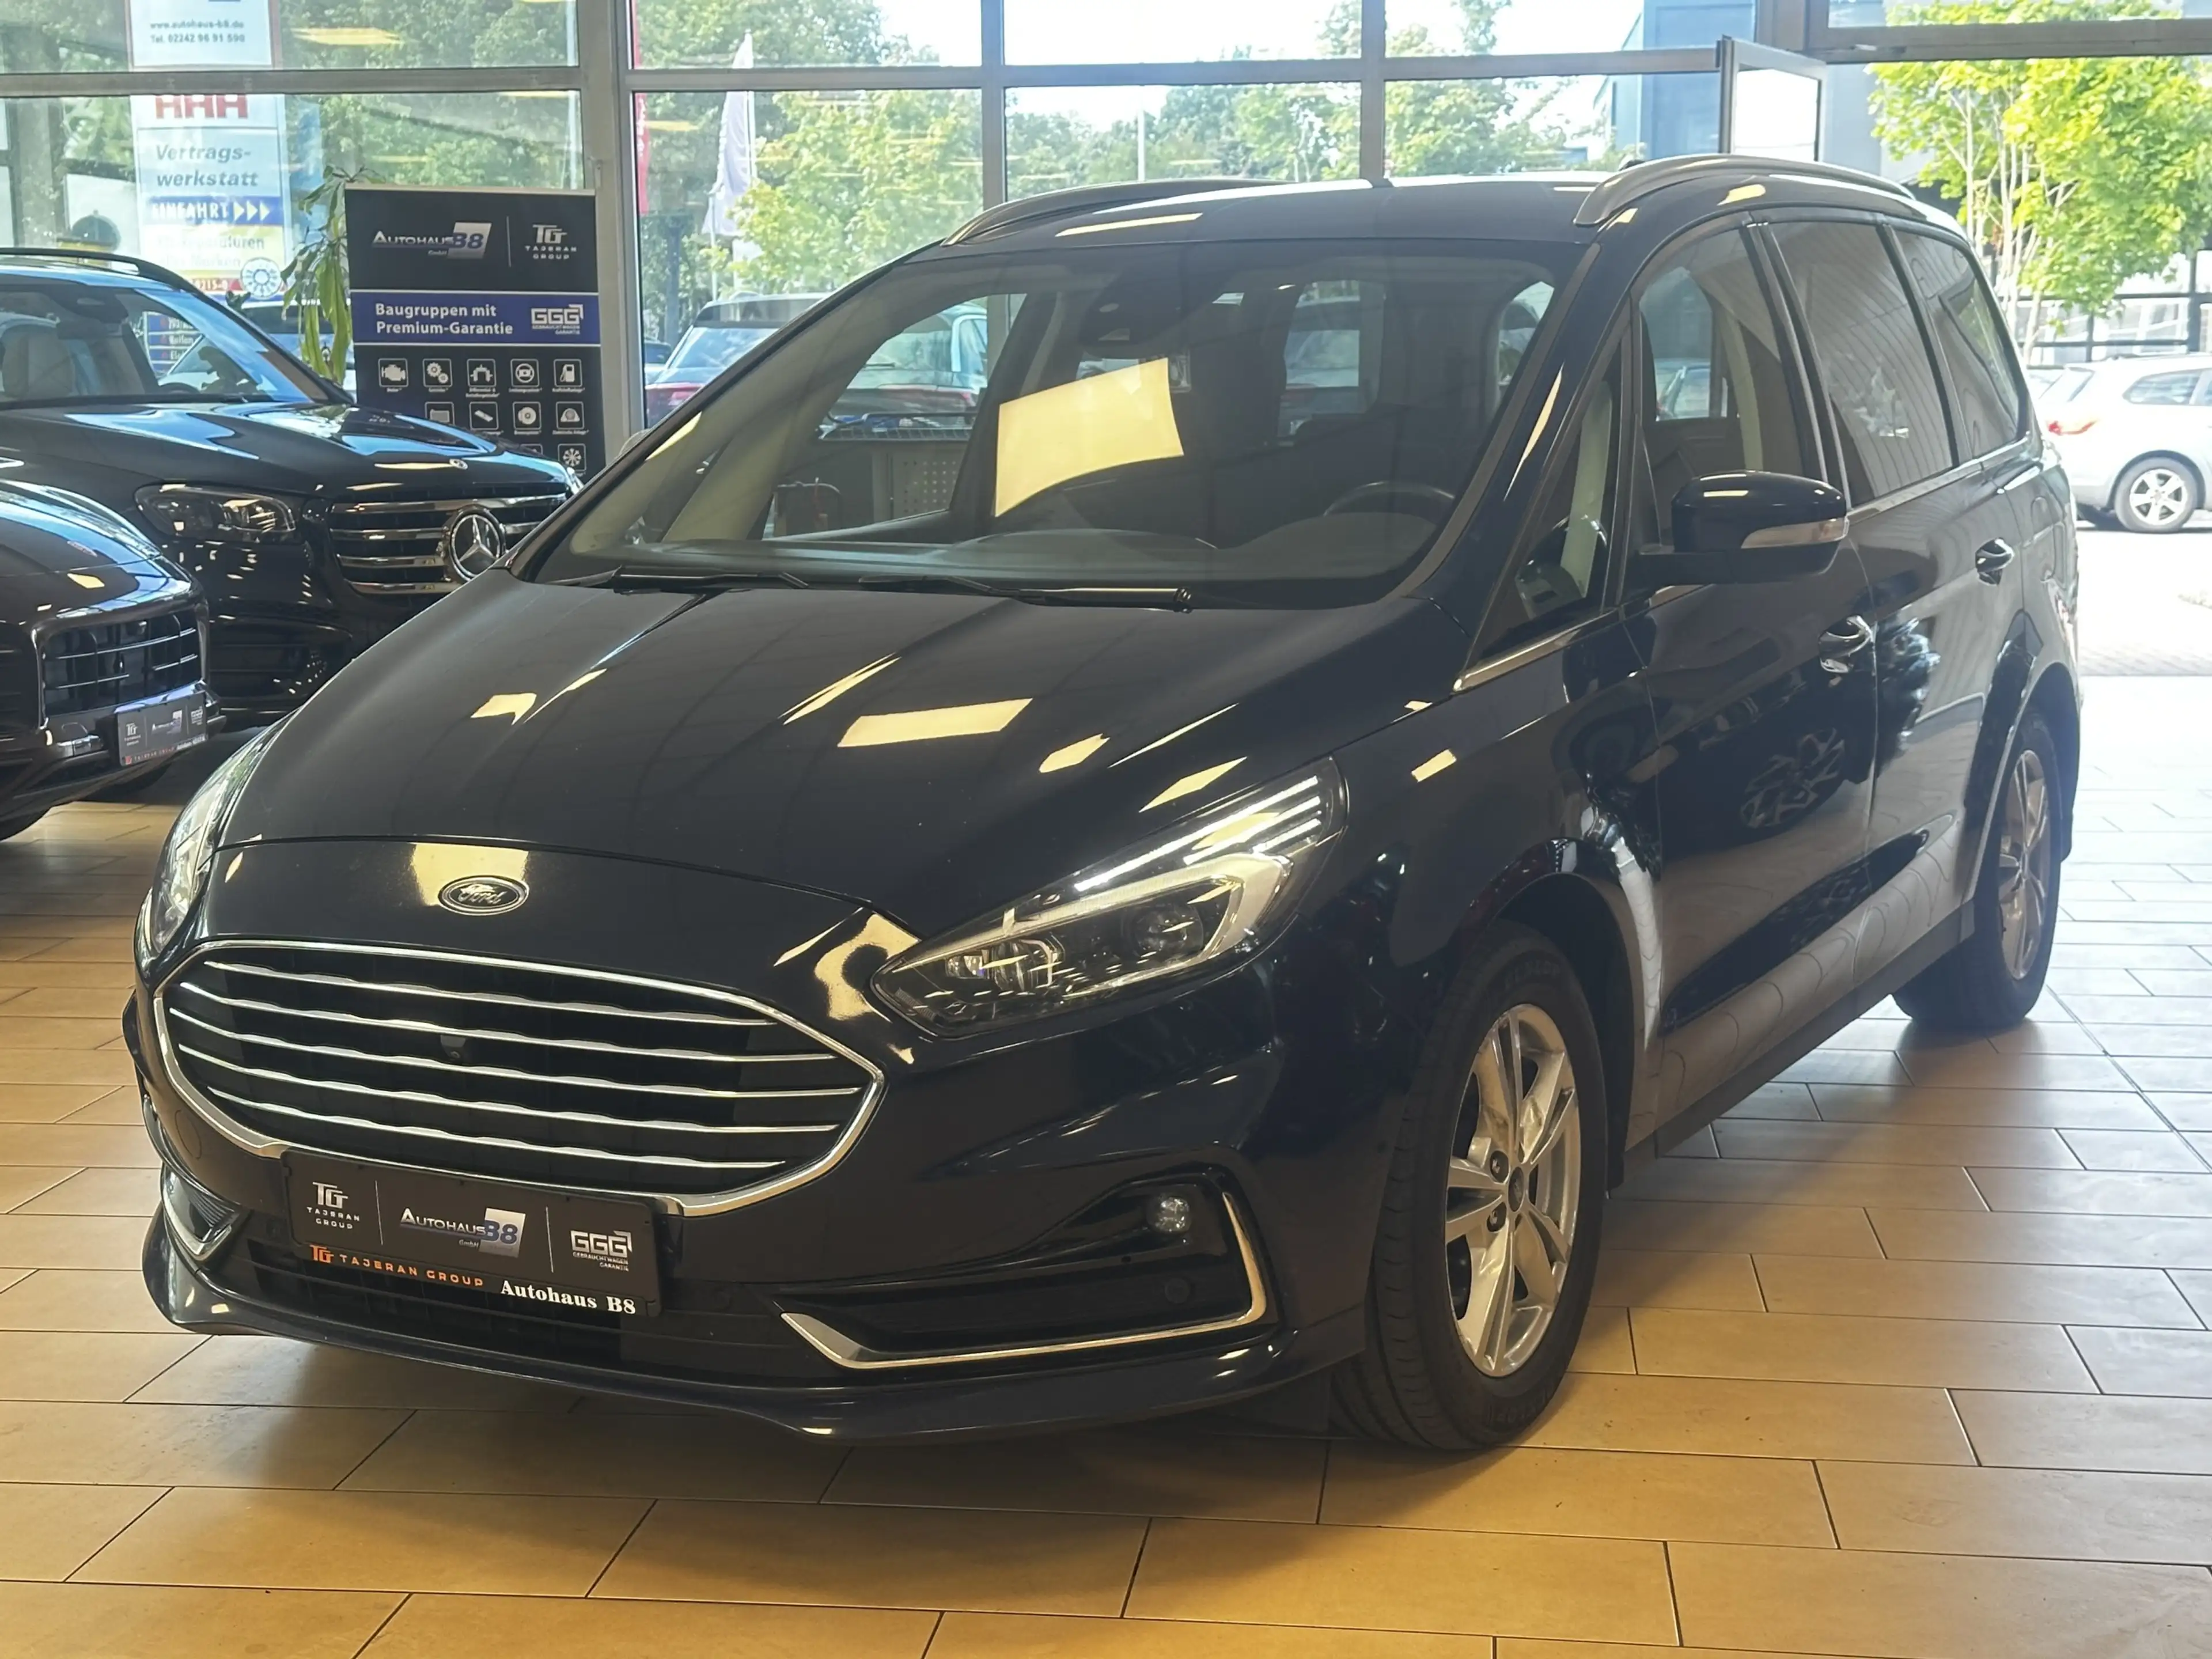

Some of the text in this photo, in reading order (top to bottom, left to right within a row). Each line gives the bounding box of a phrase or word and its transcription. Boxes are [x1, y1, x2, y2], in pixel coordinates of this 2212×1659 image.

[150, 35, 165, 43] Tel.
[168, 34, 195, 43] 02242
[156, 144, 251, 163] Vertrags-
[157, 170, 259, 187] werkstatt
[376, 303, 497, 319] Baugruppen mit
[531, 308, 580, 324] GGG
[376, 321, 513, 335] Premium-Garantie
[457, 883, 507, 905] Ford
[306, 1206, 360, 1222] TAJERAN
[315, 1218, 359, 1230] GROUP
[459, 1239, 479, 1248] GmbH
[570, 1230, 628, 1258] GGG
[339, 1253, 418, 1277] TAJERAN
[426, 1270, 484, 1287] GROUP
[500, 1279, 637, 1315] Autohaus B8
